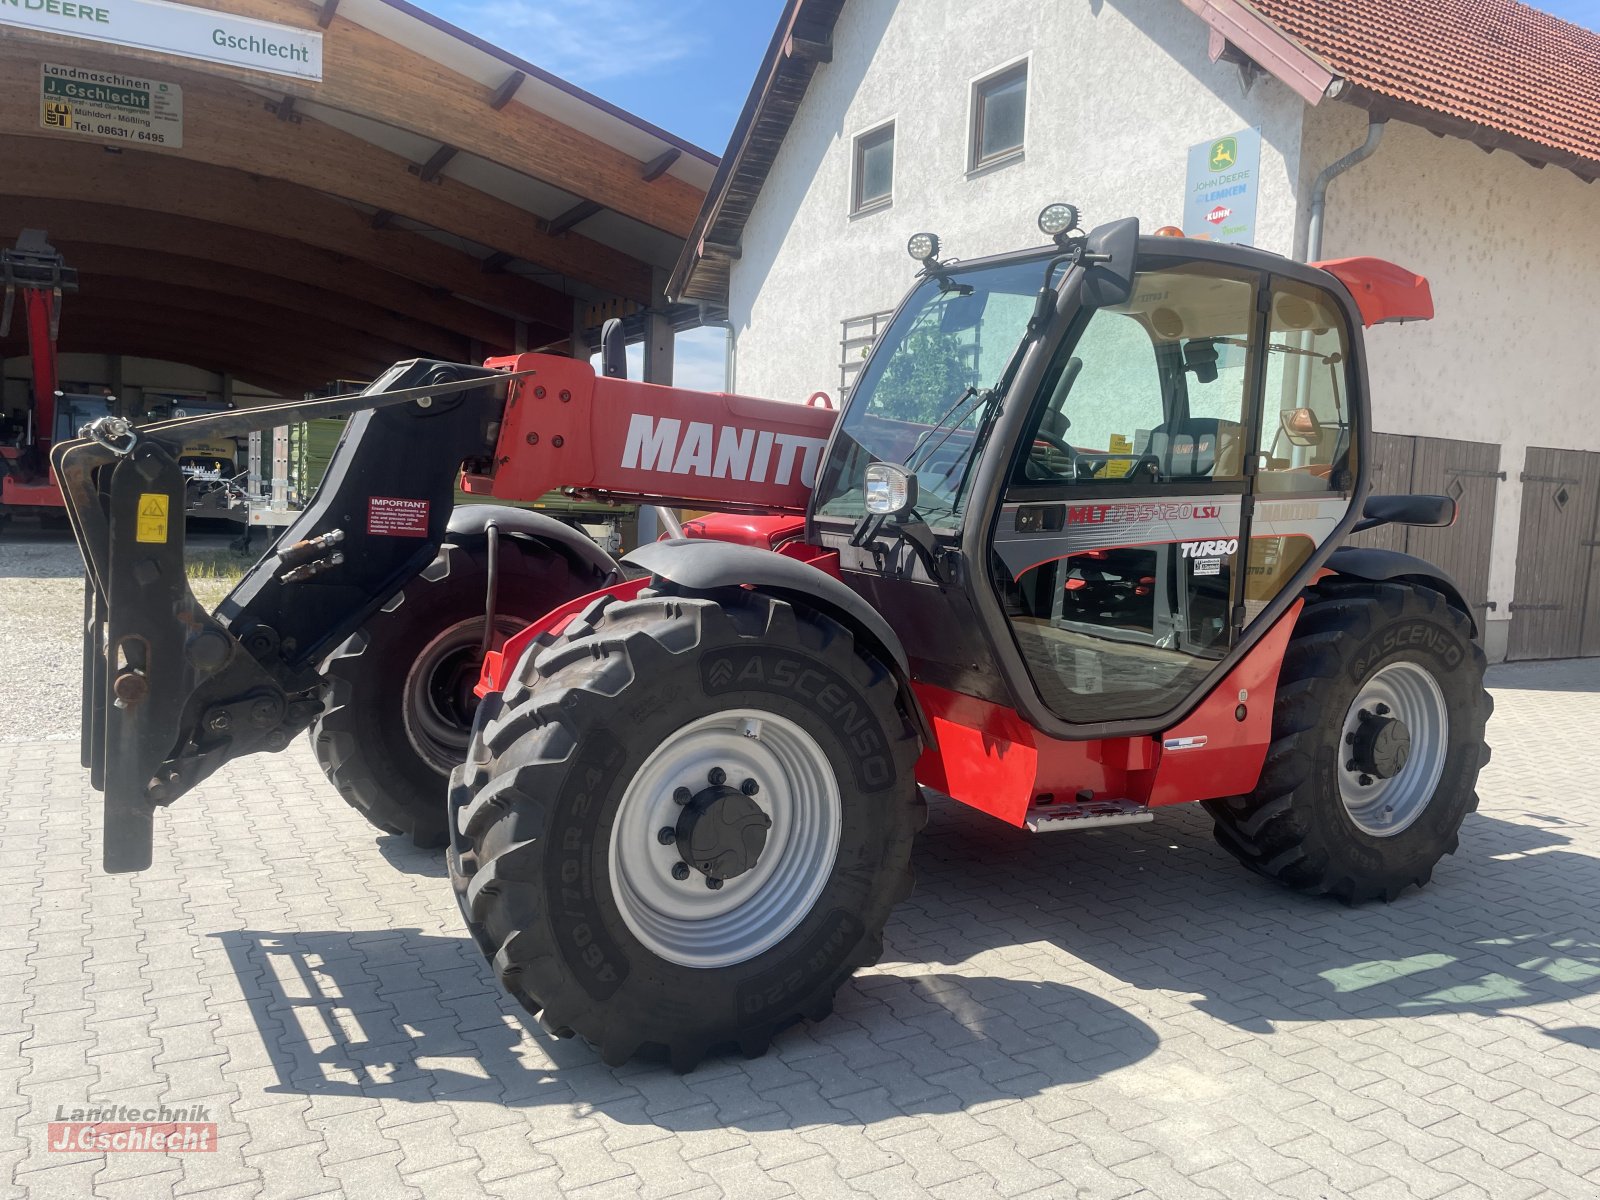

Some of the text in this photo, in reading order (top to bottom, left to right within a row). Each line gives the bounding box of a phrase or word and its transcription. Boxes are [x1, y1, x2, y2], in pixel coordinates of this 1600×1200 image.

[212, 28, 309, 63] Gschlecht
[44, 64, 150, 90] Landmaschinen
[47, 81, 147, 106] J. Gschlecht
[75, 107, 111, 120] Mühldorf
[74, 121, 94, 132] Tel.
[97, 124, 128, 137] 08631
[138, 131, 165, 143] 6495
[1193, 170, 1251, 192] JOHN DEERE
[1205, 183, 1248, 202] LEMKEN
[1206, 208, 1232, 221] KUHN
[371, 499, 427, 509] IMPORTANT
[1067, 505, 1111, 524] MLT
[1192, 506, 1221, 518] LSU
[1180, 539, 1239, 559] TURBO
[1367, 625, 1461, 667] ASCENSO
[736, 655, 892, 789] ASCENSO
